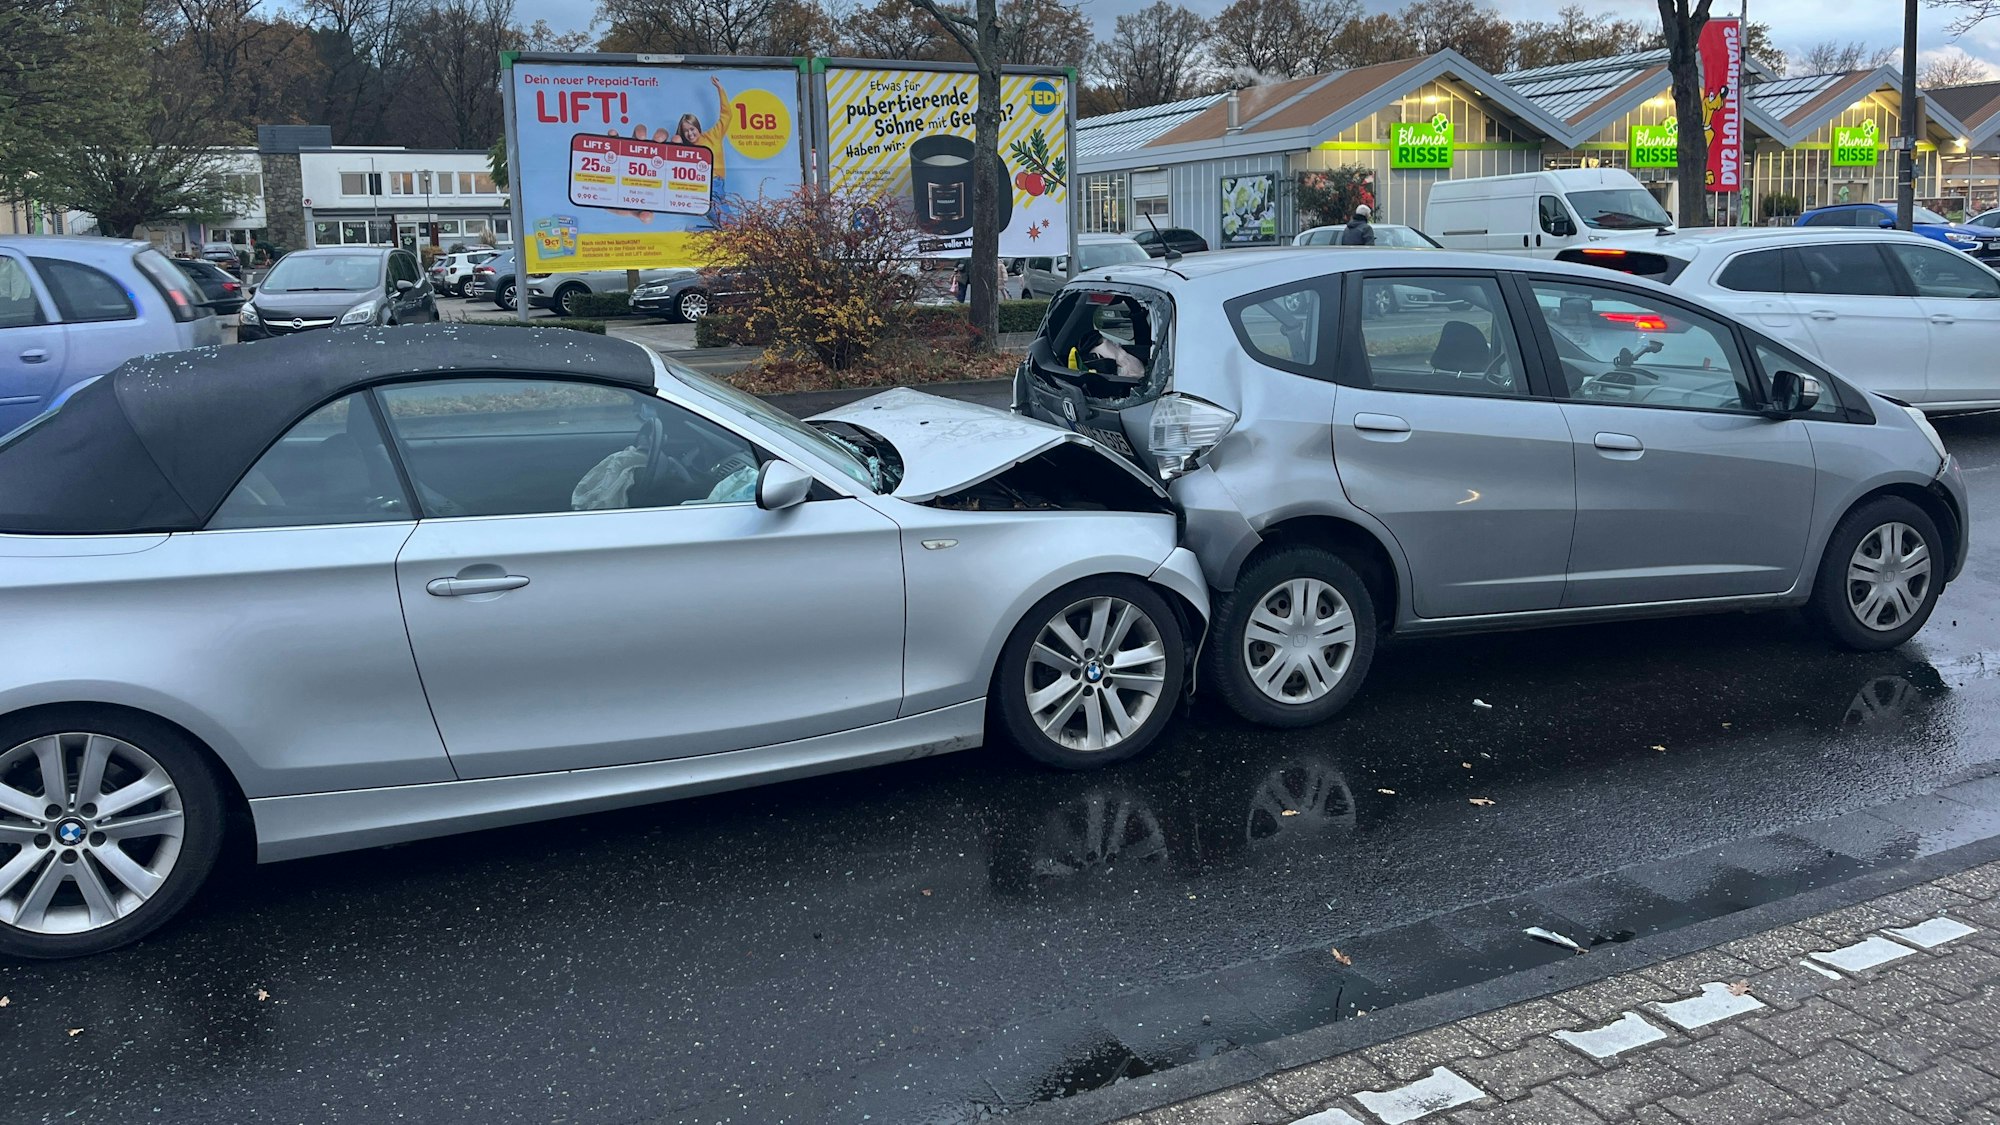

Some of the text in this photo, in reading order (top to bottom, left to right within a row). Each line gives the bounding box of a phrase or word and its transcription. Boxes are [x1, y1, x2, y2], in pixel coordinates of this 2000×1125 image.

[524, 74, 659, 88] Dein neuer Prepaid-Tarif:
[870, 80, 920, 92] Etwas für
[846, 86, 968, 124] pubertierende
[1024, 90, 1060, 106] TEDi
[536, 90, 629, 124] LIFT!
[874, 114, 924, 137] Söhne
[928, 117, 947, 129] mit
[1398, 126, 1448, 146] Blumen
[1838, 130, 1874, 147] Blumen
[583, 140, 611, 150] LIFT S
[630, 145, 658, 155] LIFT M
[846, 140, 906, 158] Haben wir:
[676, 150, 702, 160] LIFT L
[1398, 147, 1448, 162] RISSE
[1636, 148, 1678, 162] RISSE
[1838, 148, 1874, 162] RISSE
[944, 238, 963, 248] voller
